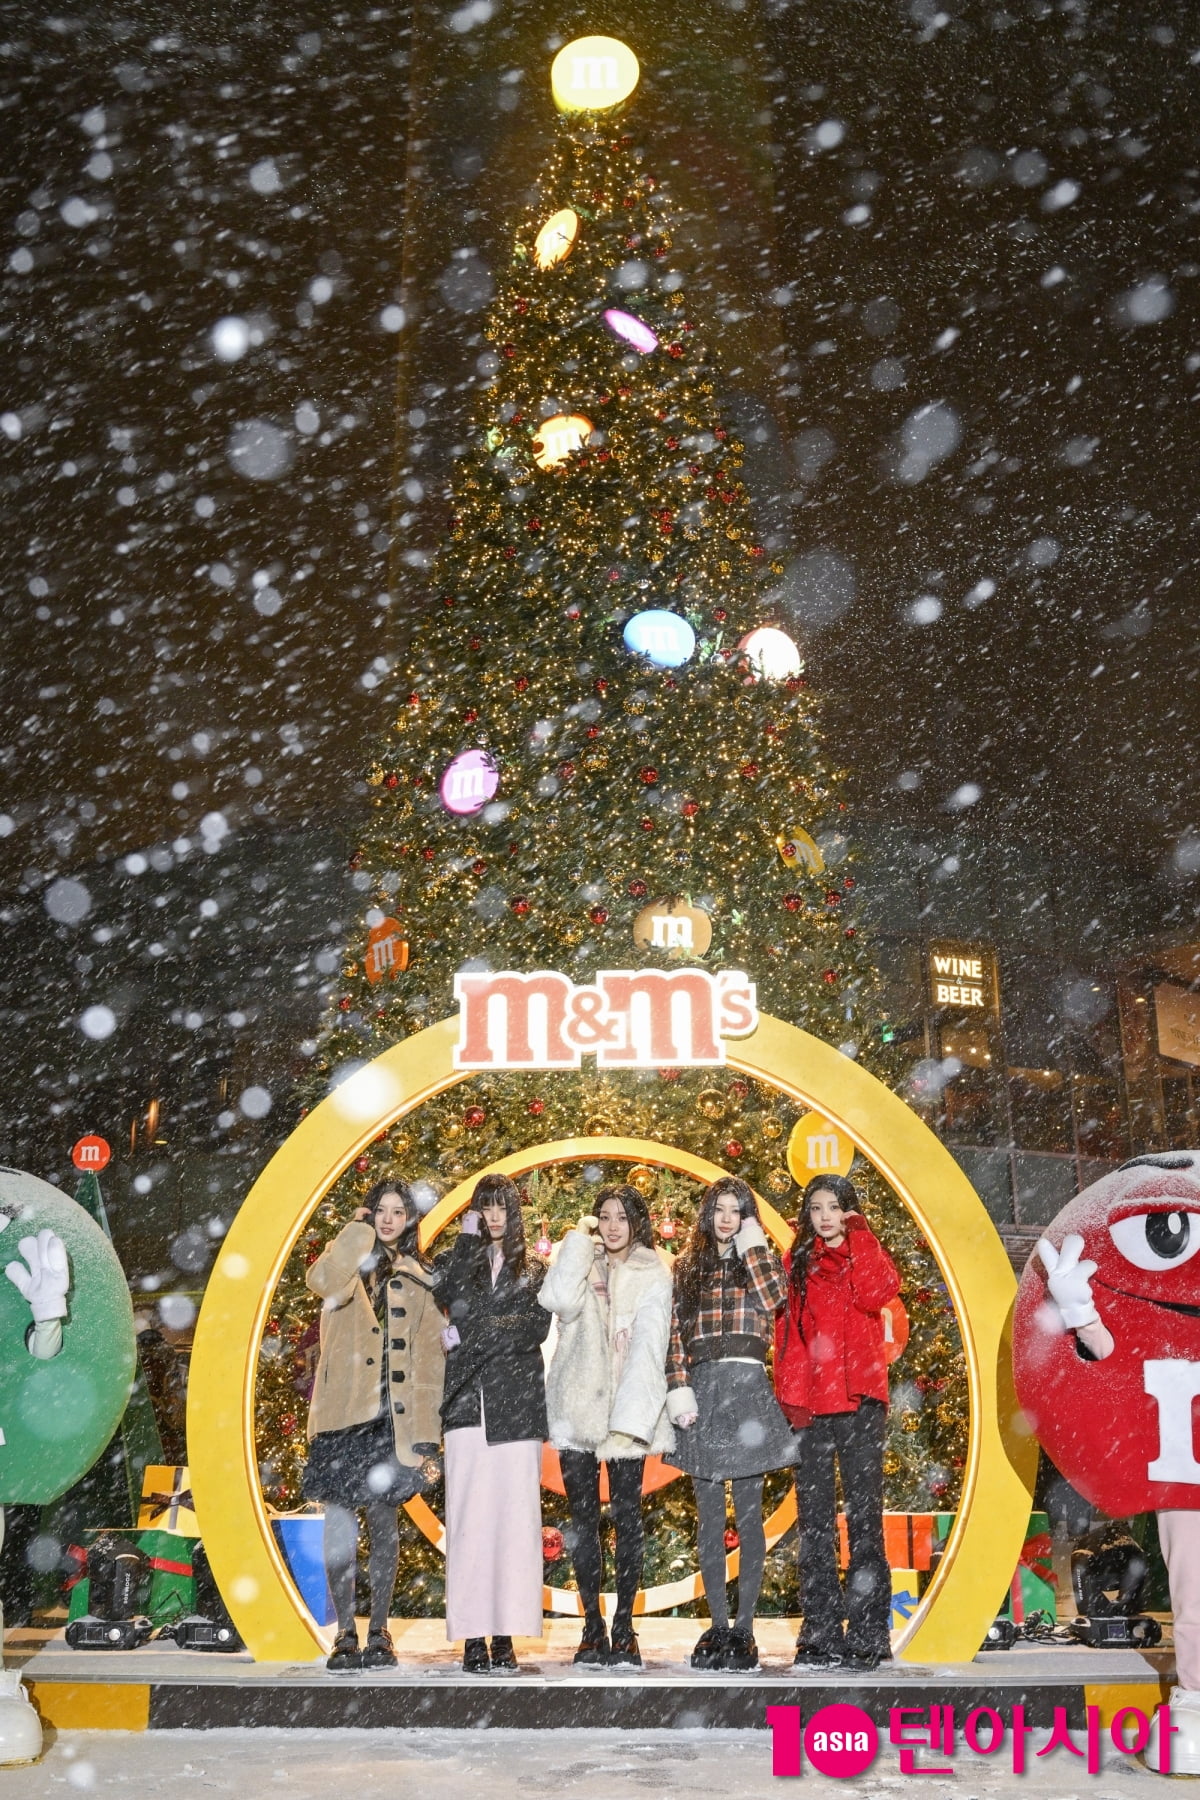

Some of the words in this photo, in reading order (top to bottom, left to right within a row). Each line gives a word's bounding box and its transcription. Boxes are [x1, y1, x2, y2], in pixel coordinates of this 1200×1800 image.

[651, 916, 694, 948] m
[933, 955, 983, 978] WINE
[937, 984, 985, 1007] BEER
